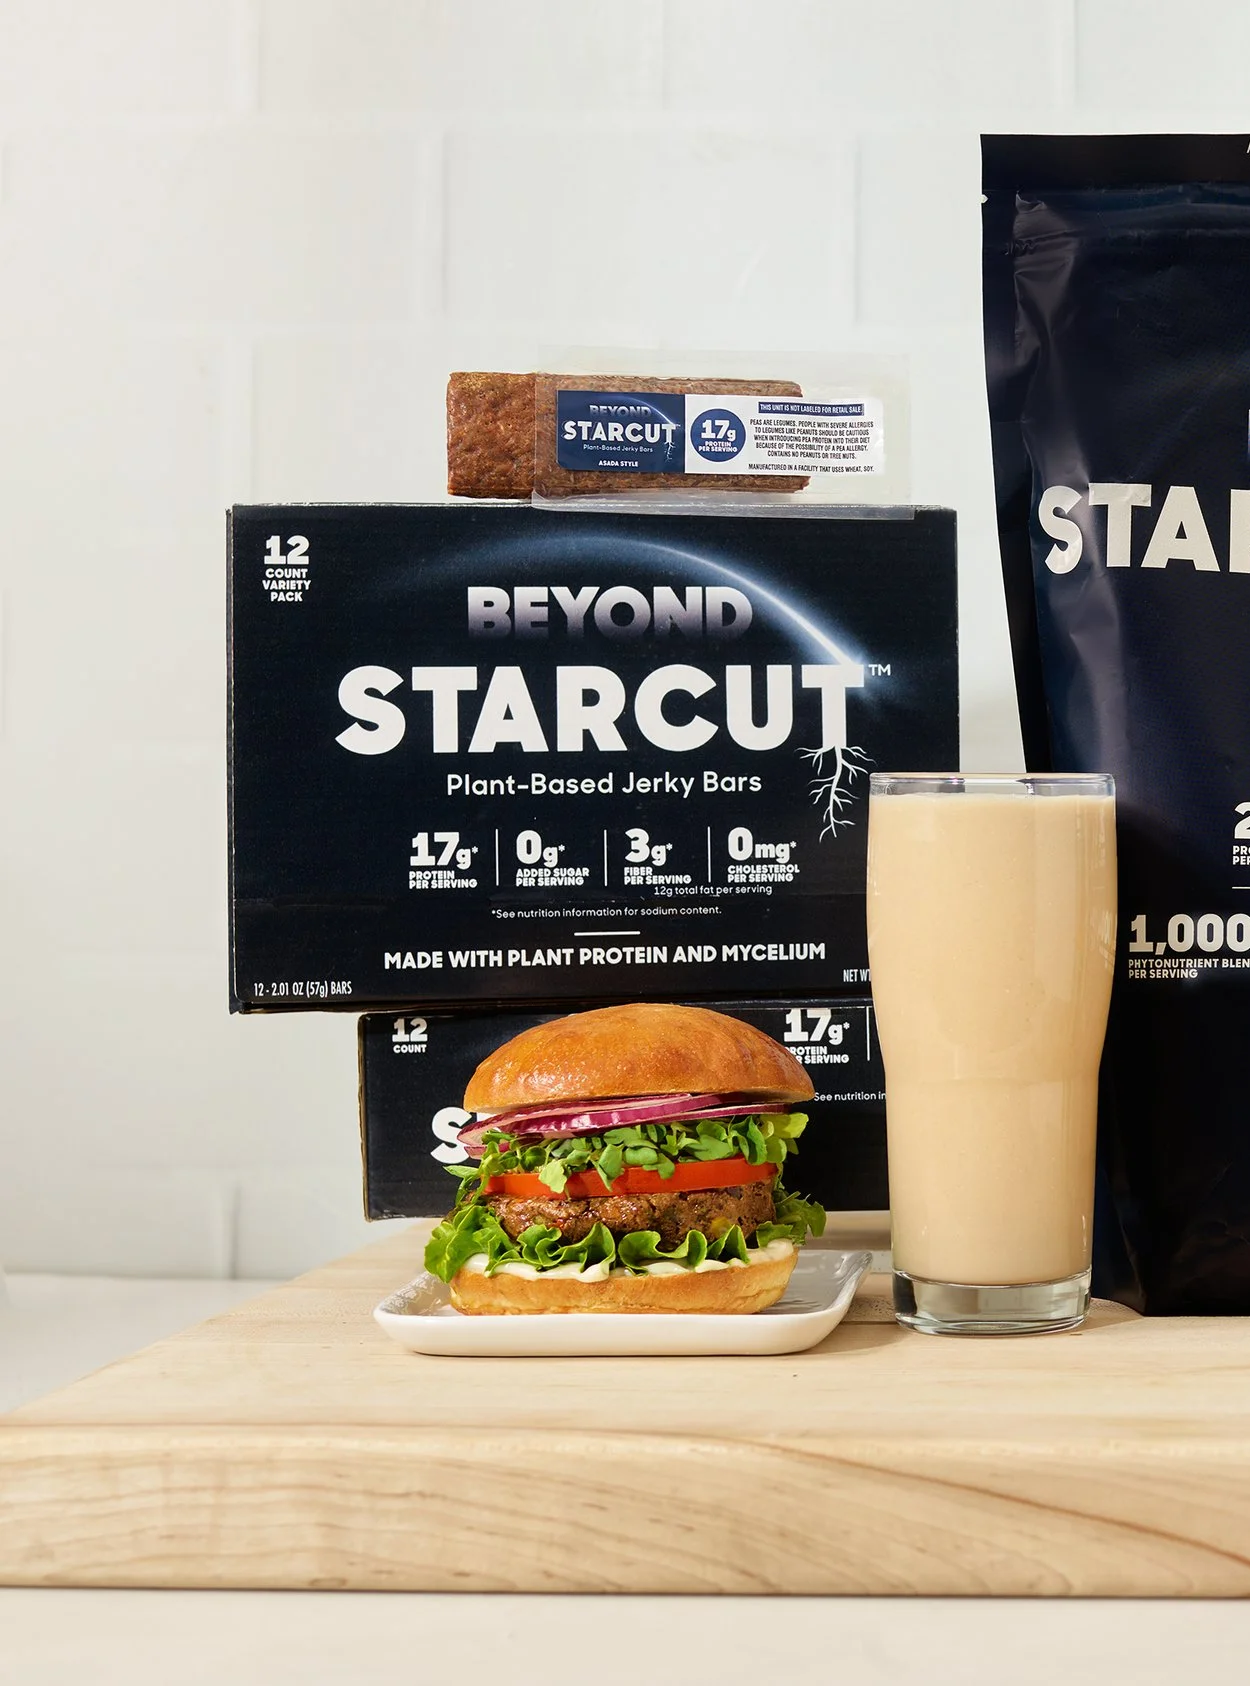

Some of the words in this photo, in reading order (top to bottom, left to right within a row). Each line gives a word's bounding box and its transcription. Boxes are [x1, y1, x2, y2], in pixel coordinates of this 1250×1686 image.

[590, 405, 651, 418] BEYOND
[701, 420, 736, 441] 17g
[264, 536, 309, 564] 12
[265, 568, 308, 579] COUNT
[262, 580, 311, 590] VARIETY
[270, 591, 303, 602] PACK
[467, 586, 752, 640] BEYOND
[447, 772, 614, 796] Plant-Based
[622, 772, 695, 798] Jerky
[704, 770, 762, 792] Bars
[516, 869, 550, 878] ADDED
[553, 868, 590, 877] SUGAR
[624, 867, 652, 876] FIBER
[728, 864, 800, 874] CHOLESTEROL
[409, 871, 455, 880] PROTEIN
[654, 887, 673, 897] 12g
[675, 886, 698, 894] total
[700, 886, 714, 894] fat
[716, 887, 733, 896] per
[736, 885, 772, 895] serving
[518, 908, 560, 918] nutrition
[563, 907, 621, 917] information
[624, 907, 638, 916] for
[641, 907, 677, 915] sodium
[680, 906, 722, 914] content.
[384, 951, 442, 969] MADE
[448, 950, 503, 968] WITH
[508, 948, 574, 967] PLANT
[580, 946, 667, 966] PROTEIN
[672, 945, 717, 963] AND
[722, 943, 826, 962] MYCELIUM
[1128, 958, 1218, 969] PHYTONUTRIENT
[1128, 968, 1149, 979] PER
[1152, 968, 1198, 979] SERVING
[254, 983, 264, 996] 12
[272, 982, 288, 996] 2.01
[293, 982, 304, 995] OZ
[306, 981, 328, 998] (57g)
[331, 981, 352, 994] BARS
[392, 1017, 428, 1041] 12
[393, 1044, 427, 1054] COUNT
[835, 1092, 876, 1100] nutrition
